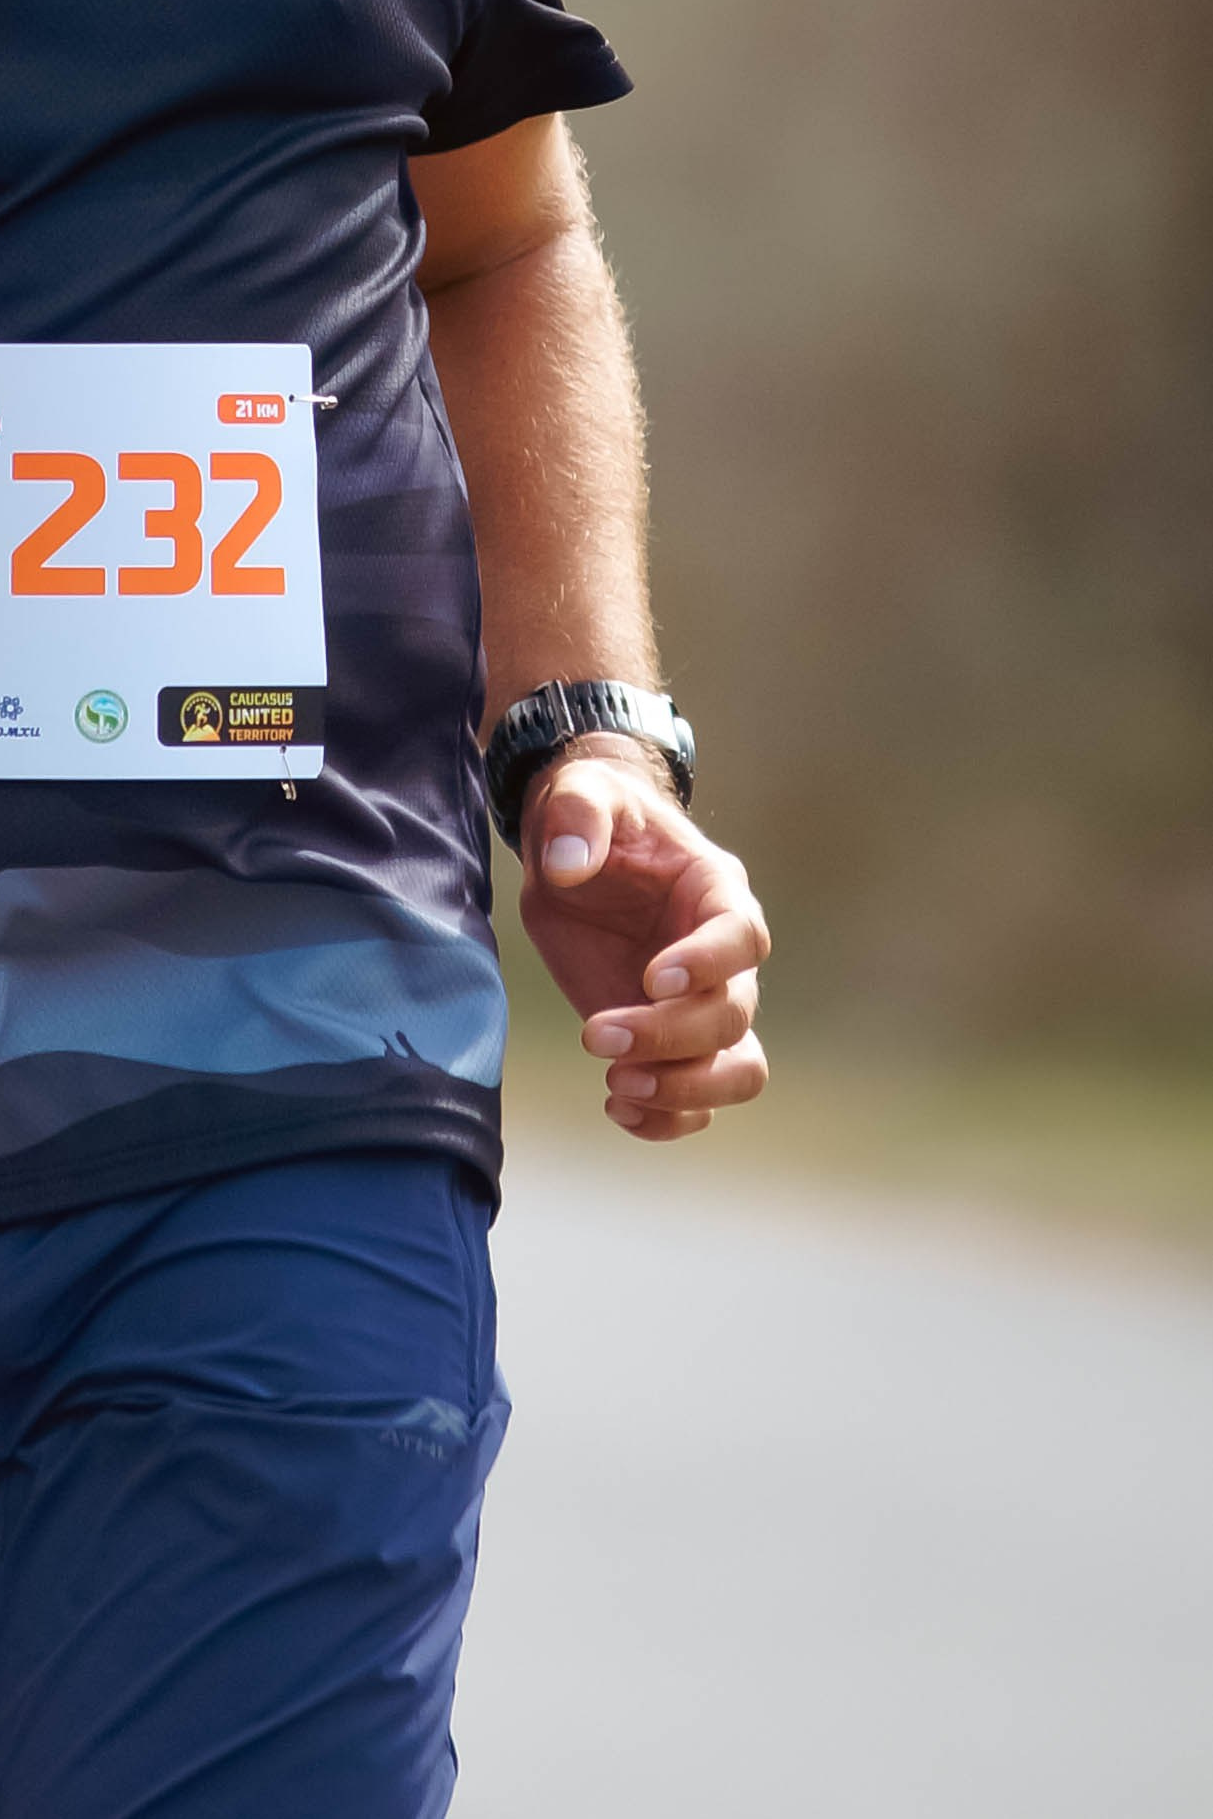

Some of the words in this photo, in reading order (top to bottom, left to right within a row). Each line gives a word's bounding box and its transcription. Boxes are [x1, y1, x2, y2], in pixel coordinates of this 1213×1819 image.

[235, 399, 253, 418] 21
[10, 451, 286, 596] 232
[229, 692, 294, 706] CAUCASUS
[228, 708, 294, 726] UNITED
[228, 728, 294, 742] TERRITORY
